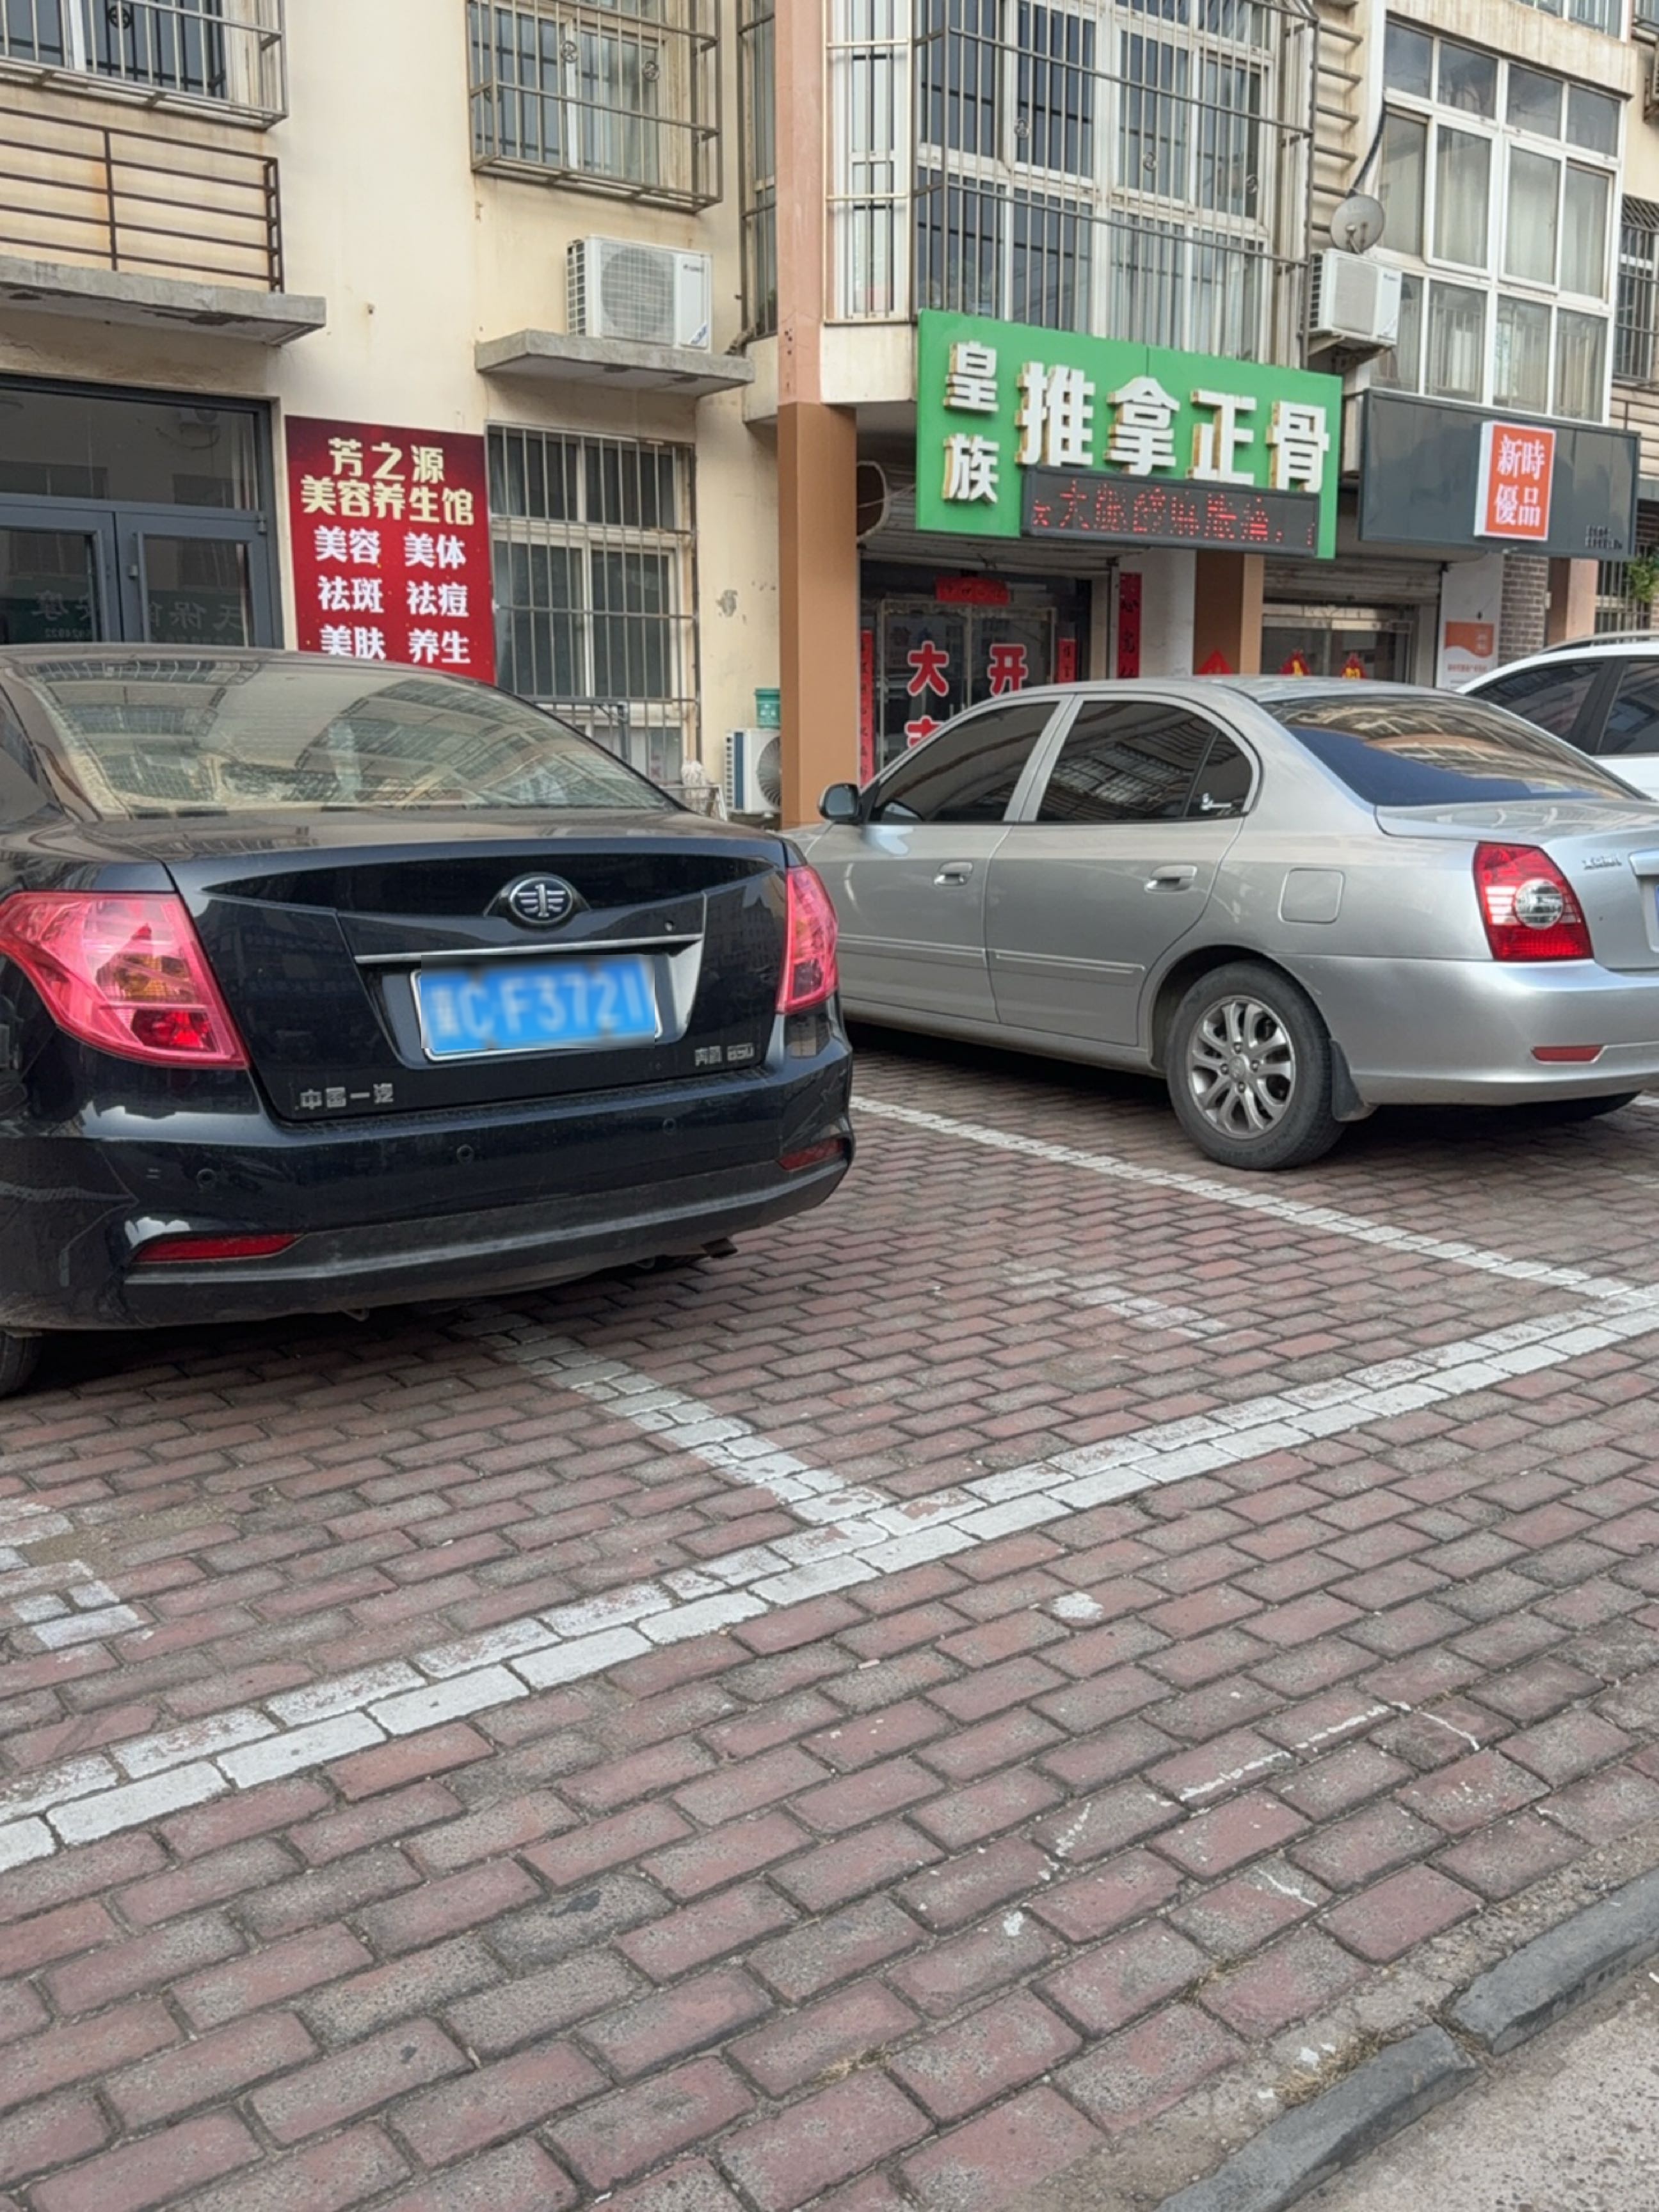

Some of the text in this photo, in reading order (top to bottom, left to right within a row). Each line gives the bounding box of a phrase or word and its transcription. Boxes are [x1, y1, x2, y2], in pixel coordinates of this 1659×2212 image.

[943, 341, 1000, 504] 皇族
[1015, 360, 1329, 493] 推拿正骨
[328, 437, 444, 484] 芳之源
[1497, 434, 1545, 479] 新時
[300, 476, 474, 525] 美容养生馆
[1494, 483, 1541, 527] 優品
[314, 525, 466, 570] 美容 美体
[317, 576, 469, 618] 祛斑 祛痘
[319, 624, 471, 664] 美肤 养生
[907, 640, 949, 696] 大
[987, 643, 1029, 696] 开
[300, 1083, 394, 1110] 中国一汽
